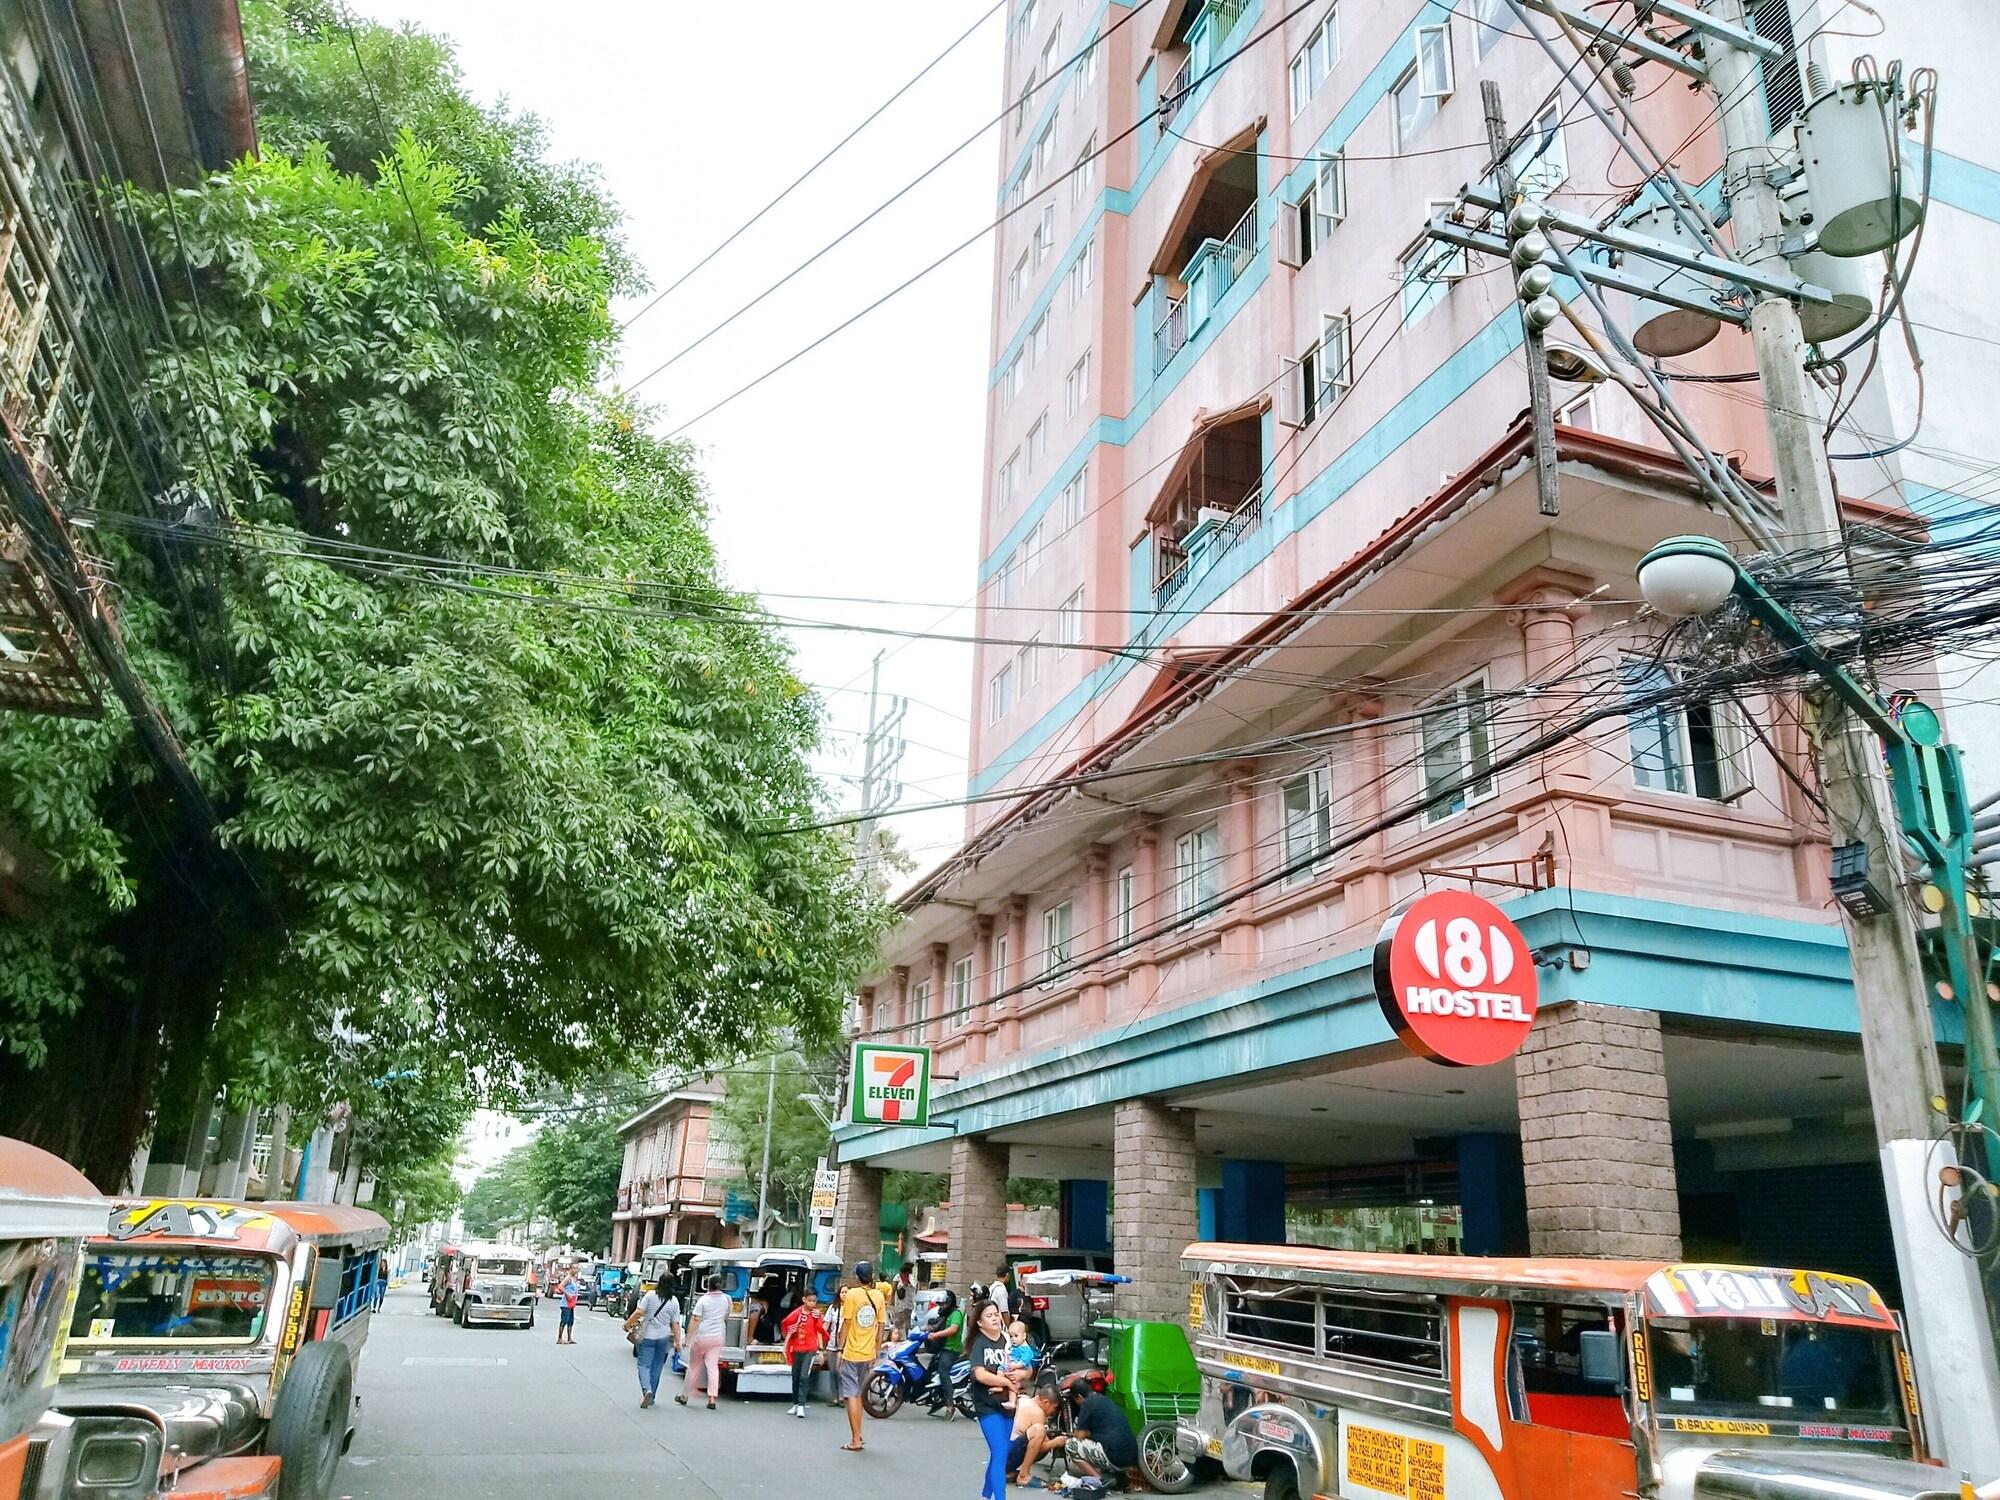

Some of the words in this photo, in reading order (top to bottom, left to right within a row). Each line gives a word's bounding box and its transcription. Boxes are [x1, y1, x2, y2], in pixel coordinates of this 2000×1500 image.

[1406, 985, 1533, 1023] HOSTEL
[873, 1055, 915, 1121] 7
[826, 1173, 836, 1182] NO
[815, 1182, 836, 1190] PARKING
[116, 1359, 182, 1371] BEVERLY
